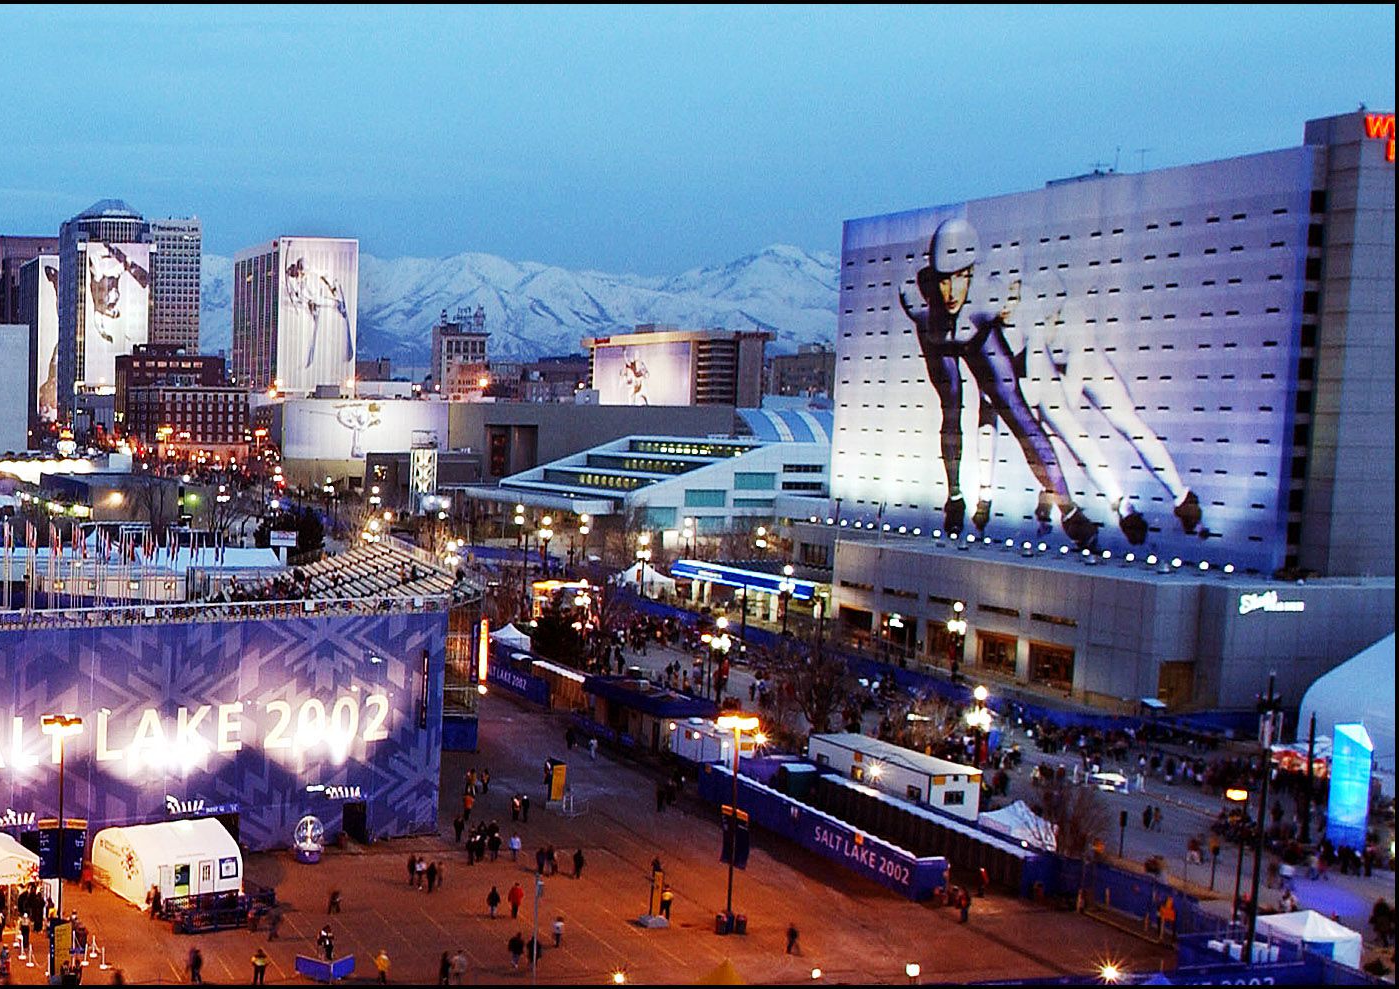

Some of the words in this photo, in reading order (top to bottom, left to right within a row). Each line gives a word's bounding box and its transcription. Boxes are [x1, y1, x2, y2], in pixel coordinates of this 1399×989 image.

[96, 702, 245, 763] LAKE
[263, 695, 390, 756] 2002
[814, 826, 842, 851] SALT
[844, 841, 876, 868] LAKE
[879, 857, 909, 885] 2002
